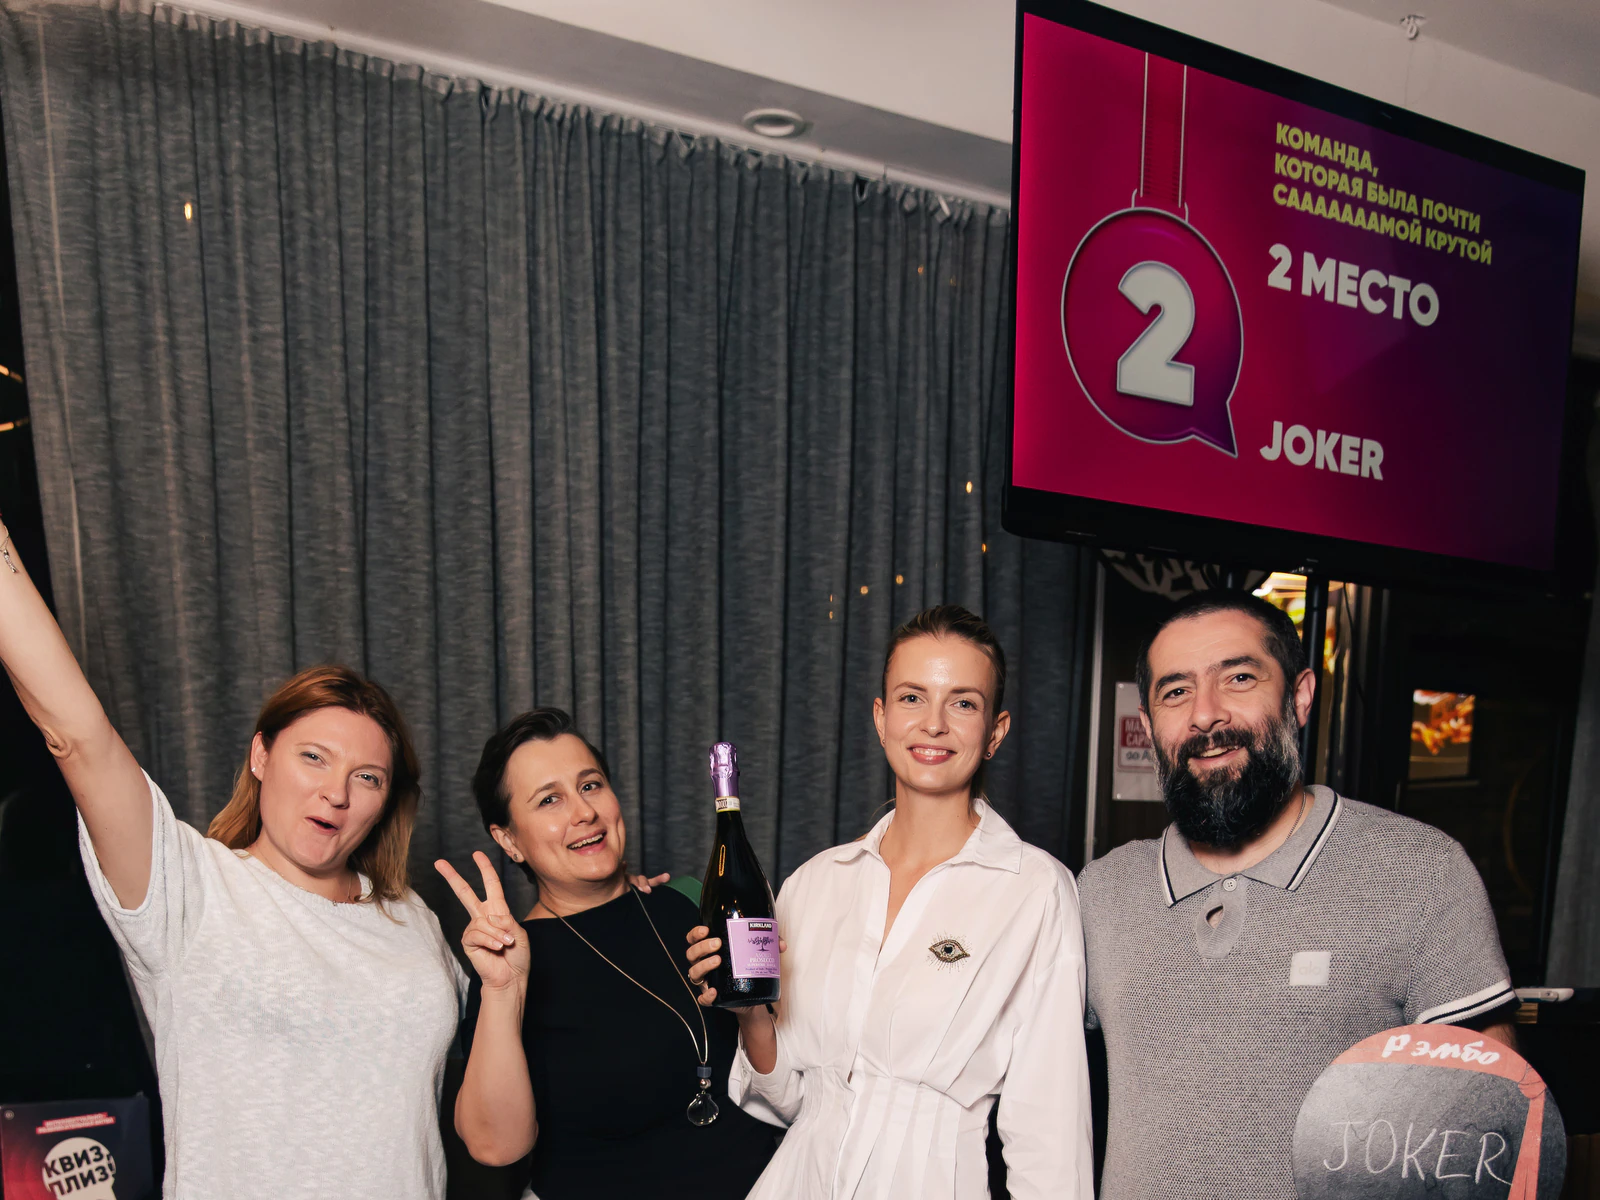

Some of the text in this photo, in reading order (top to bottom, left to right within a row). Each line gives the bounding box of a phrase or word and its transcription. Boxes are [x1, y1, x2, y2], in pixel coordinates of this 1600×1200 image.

[1275, 122, 1379, 177] КОМАНДА,
[1272, 183, 1493, 266] САААААААМОЙ КРУТОЙ
[1274, 152, 1481, 234] КОТОРАЯ БЫЛА ПОЧТИ
[1267, 243, 1440, 327] 2 МЕСТО
[1117, 261, 1195, 406] 2
[1259, 420, 1384, 481] JOKER
[1323, 1119, 1513, 1186] JOKER
